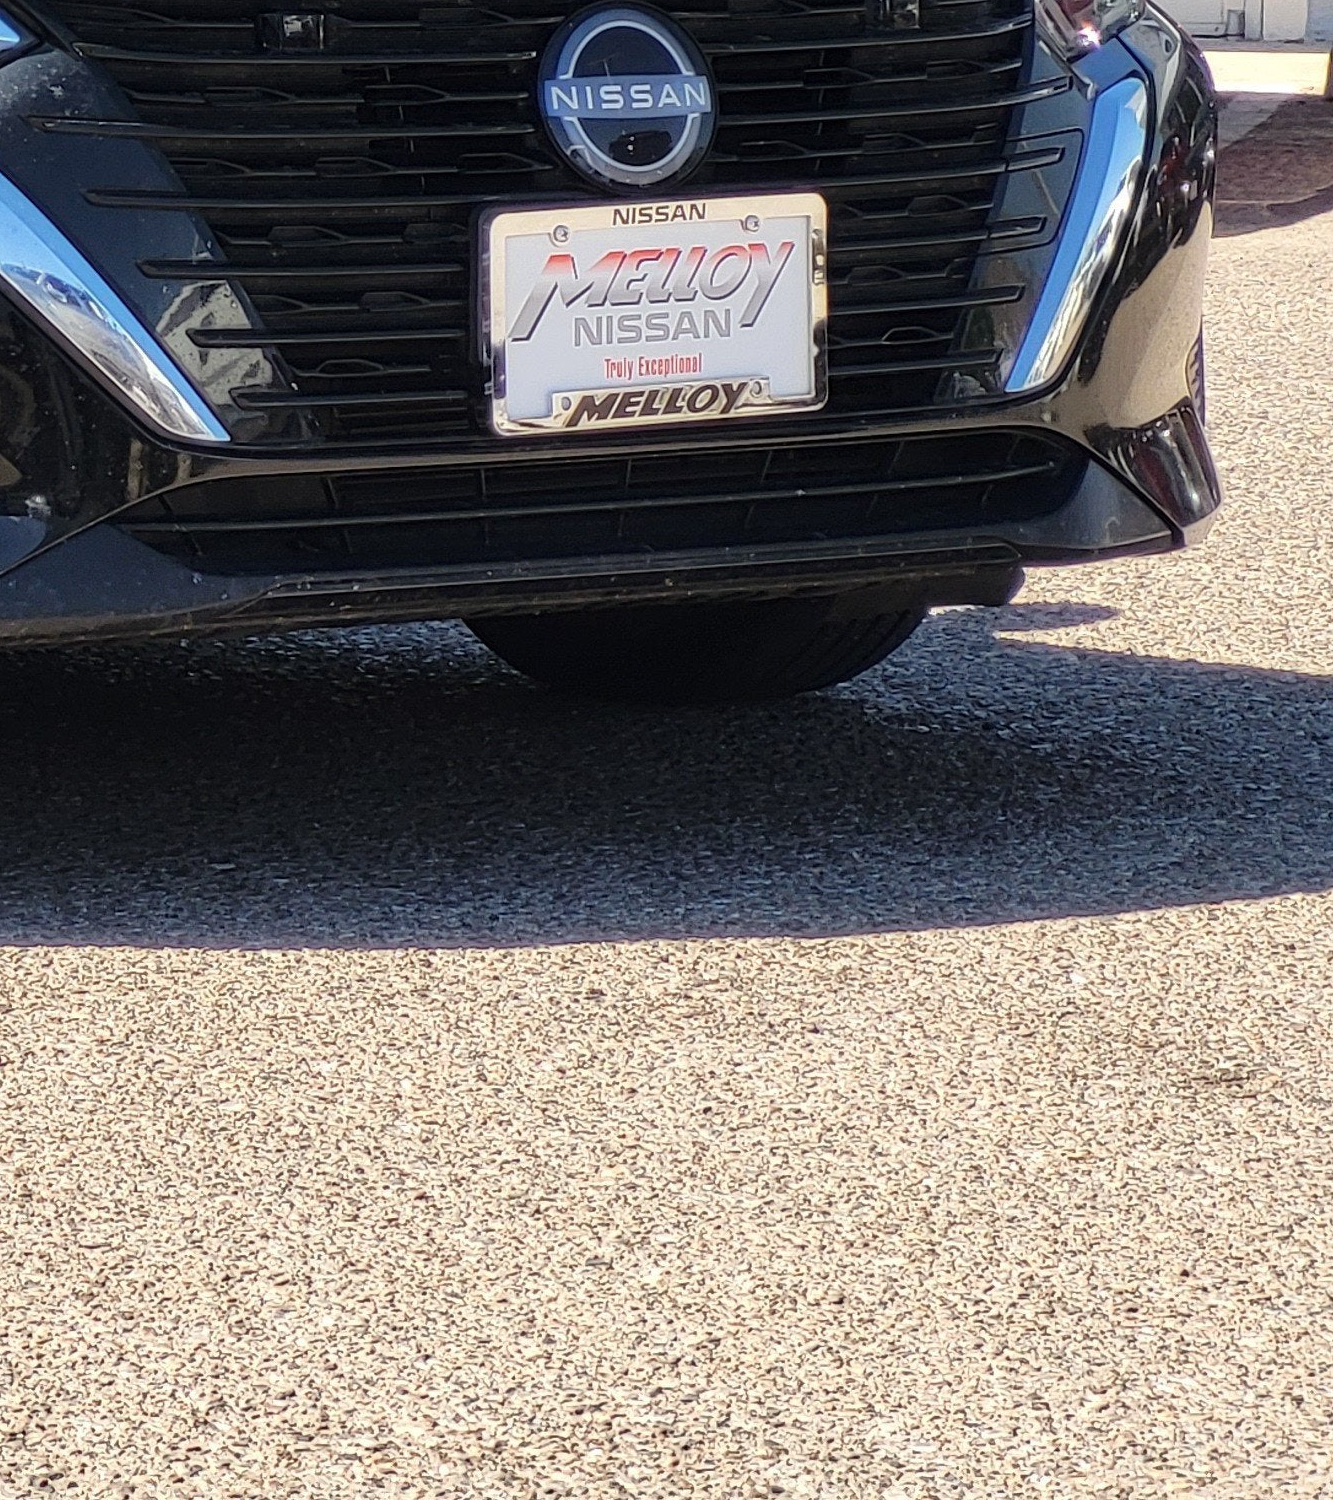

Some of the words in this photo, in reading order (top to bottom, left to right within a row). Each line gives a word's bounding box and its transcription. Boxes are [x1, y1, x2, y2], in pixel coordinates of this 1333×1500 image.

[550, 82, 706, 111] NISSAN
[611, 202, 707, 226] NISSAN
[507, 241, 796, 343] MELLOY
[573, 308, 732, 347] NISSAN
[604, 357, 634, 381] Truly
[638, 353, 703, 378] Exceptional
[561, 380, 748, 428] MELLOY
